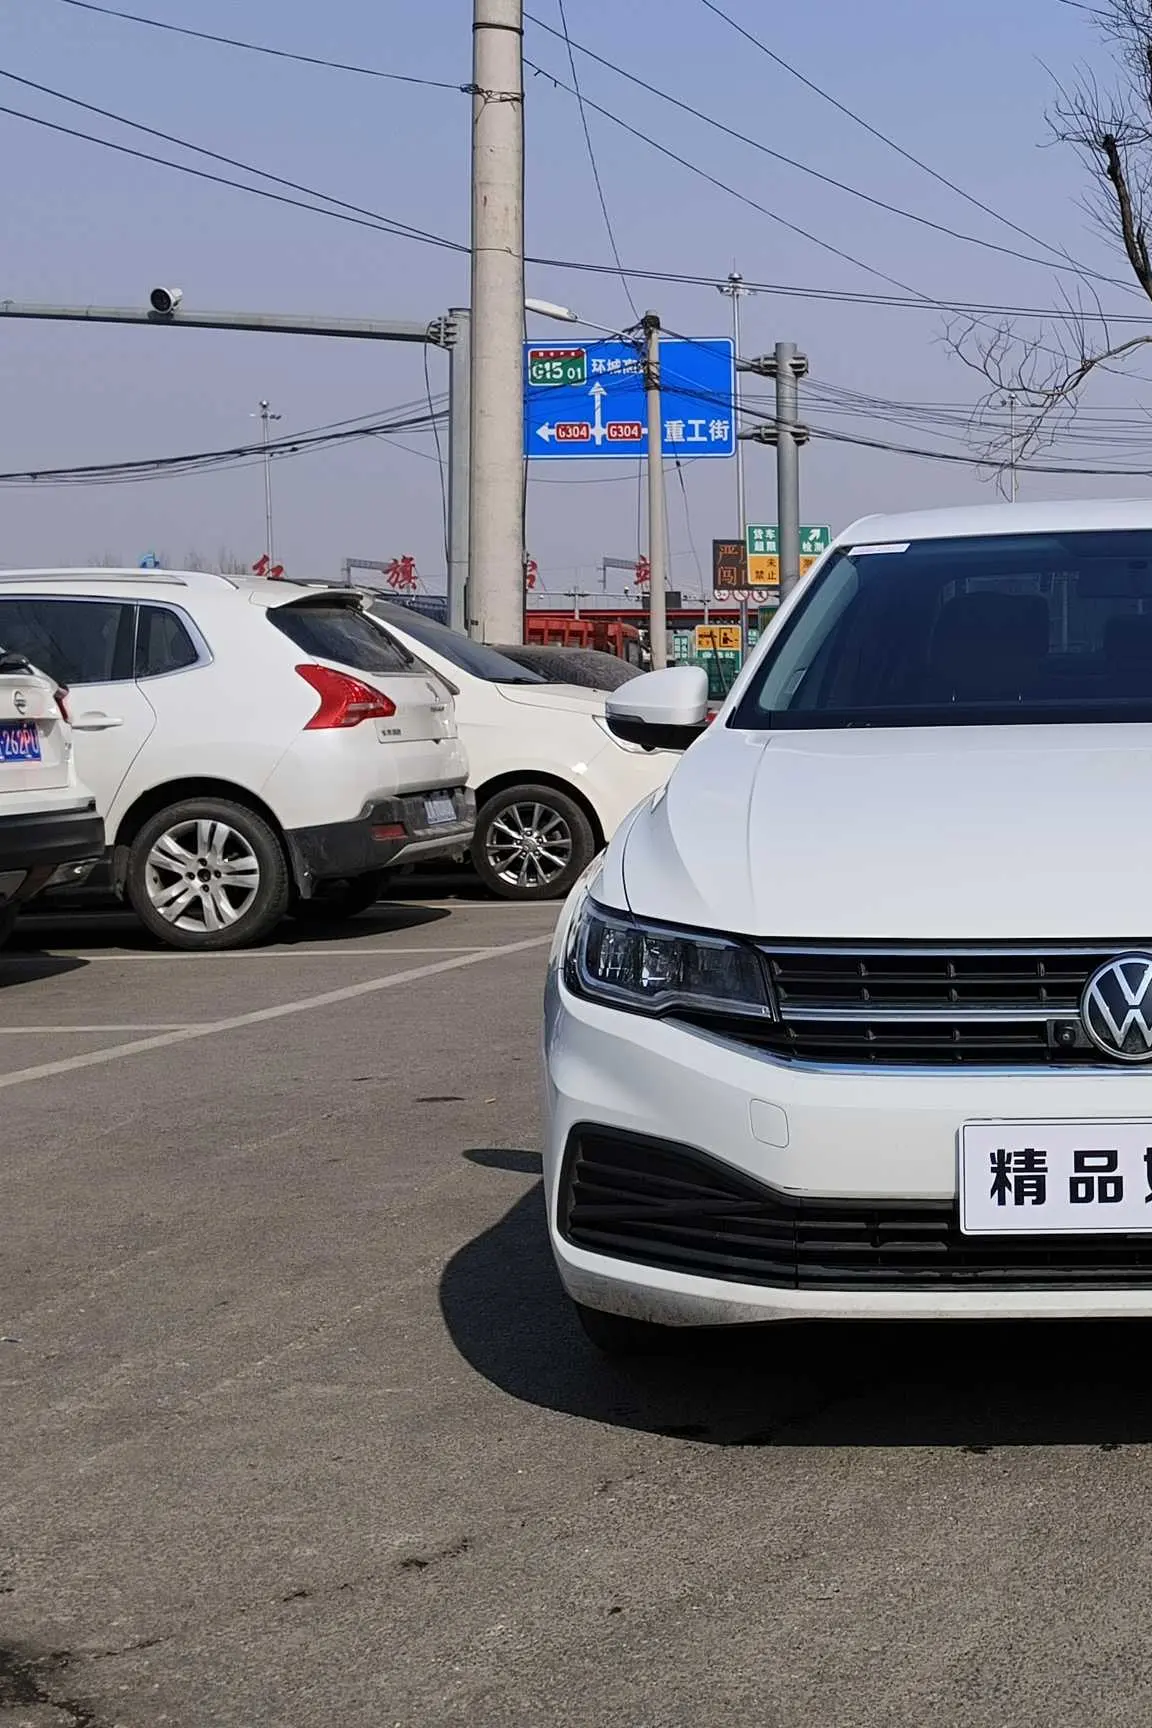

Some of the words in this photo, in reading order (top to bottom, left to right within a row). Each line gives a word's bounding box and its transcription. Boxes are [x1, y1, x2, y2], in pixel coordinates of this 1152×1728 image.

[558, 426, 588, 438] G304
[609, 425, 639, 438] G304
[663, 420, 730, 442] 重工街
